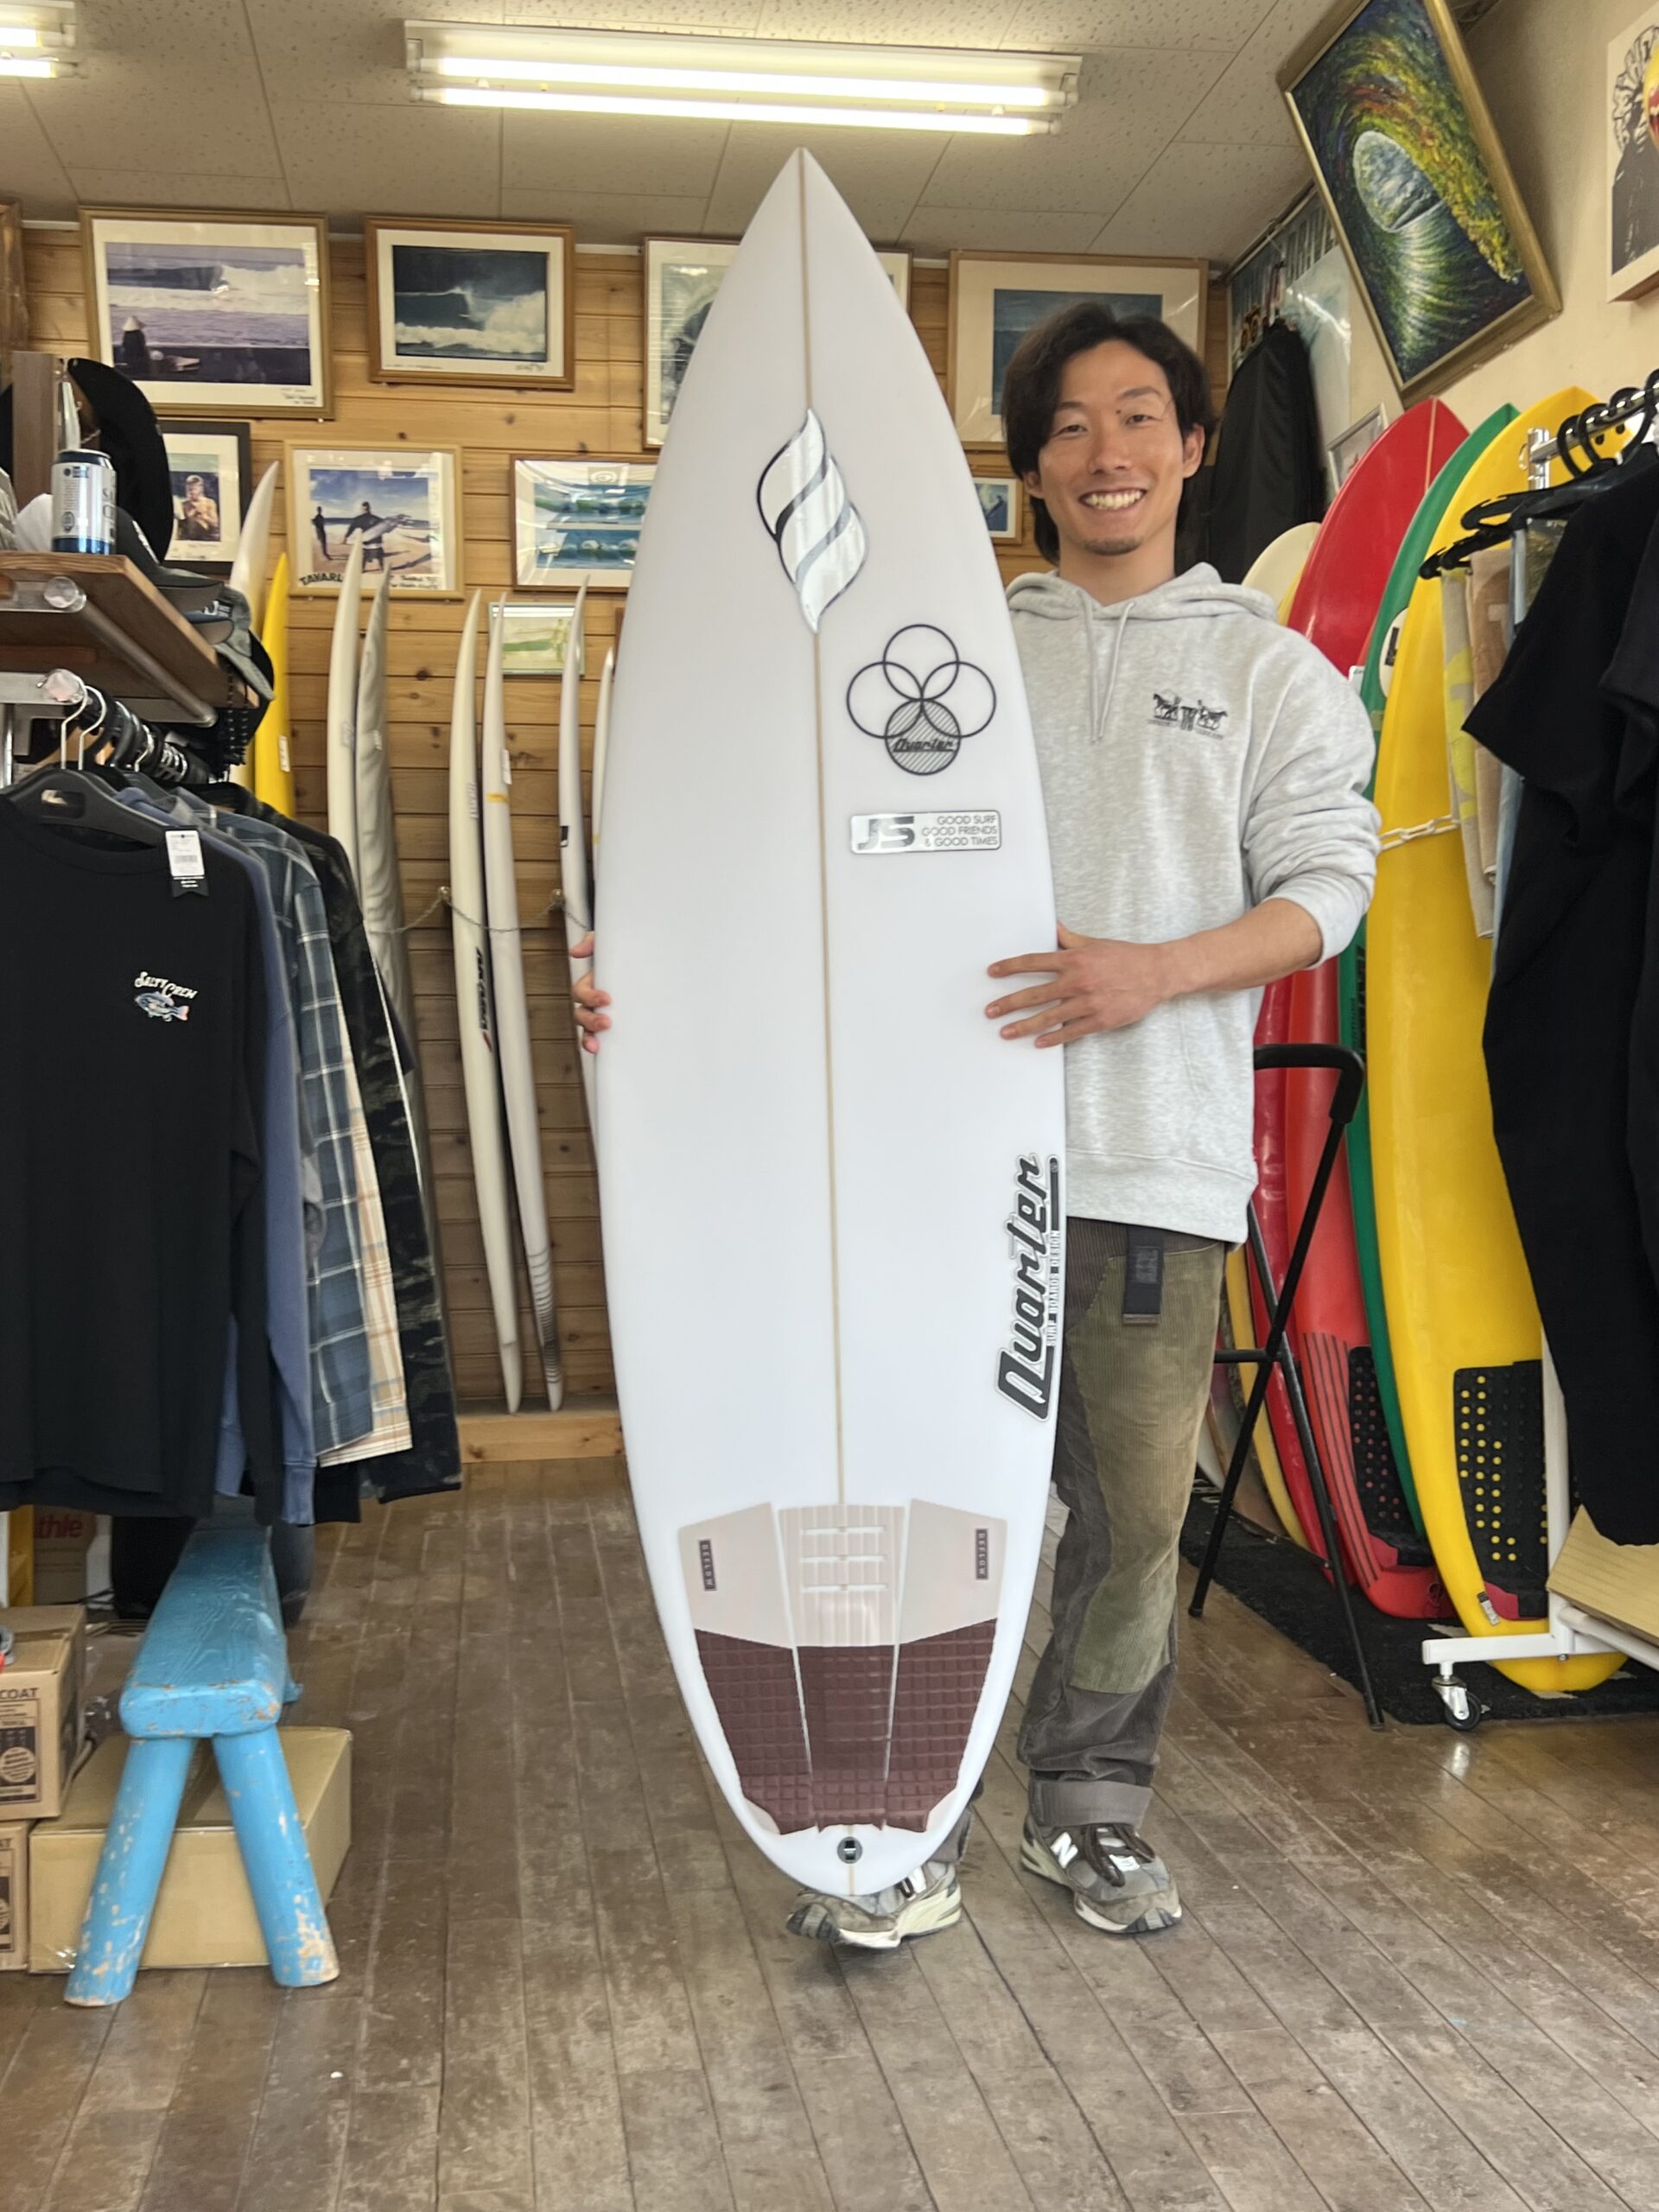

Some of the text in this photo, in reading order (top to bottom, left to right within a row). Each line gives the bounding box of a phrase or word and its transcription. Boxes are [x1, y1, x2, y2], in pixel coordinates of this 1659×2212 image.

[921, 825, 997, 836] GOOD FRIENDS
[937, 815, 996, 825] GOOD SURF
[857, 816, 915, 851] JS
[934, 836, 969, 847] GOOD
[971, 836, 998, 846] TIMES
[996, 1154, 1052, 1422] Quarter
[1046, 1230, 1060, 1347] SURF BOARDS DESIGN
